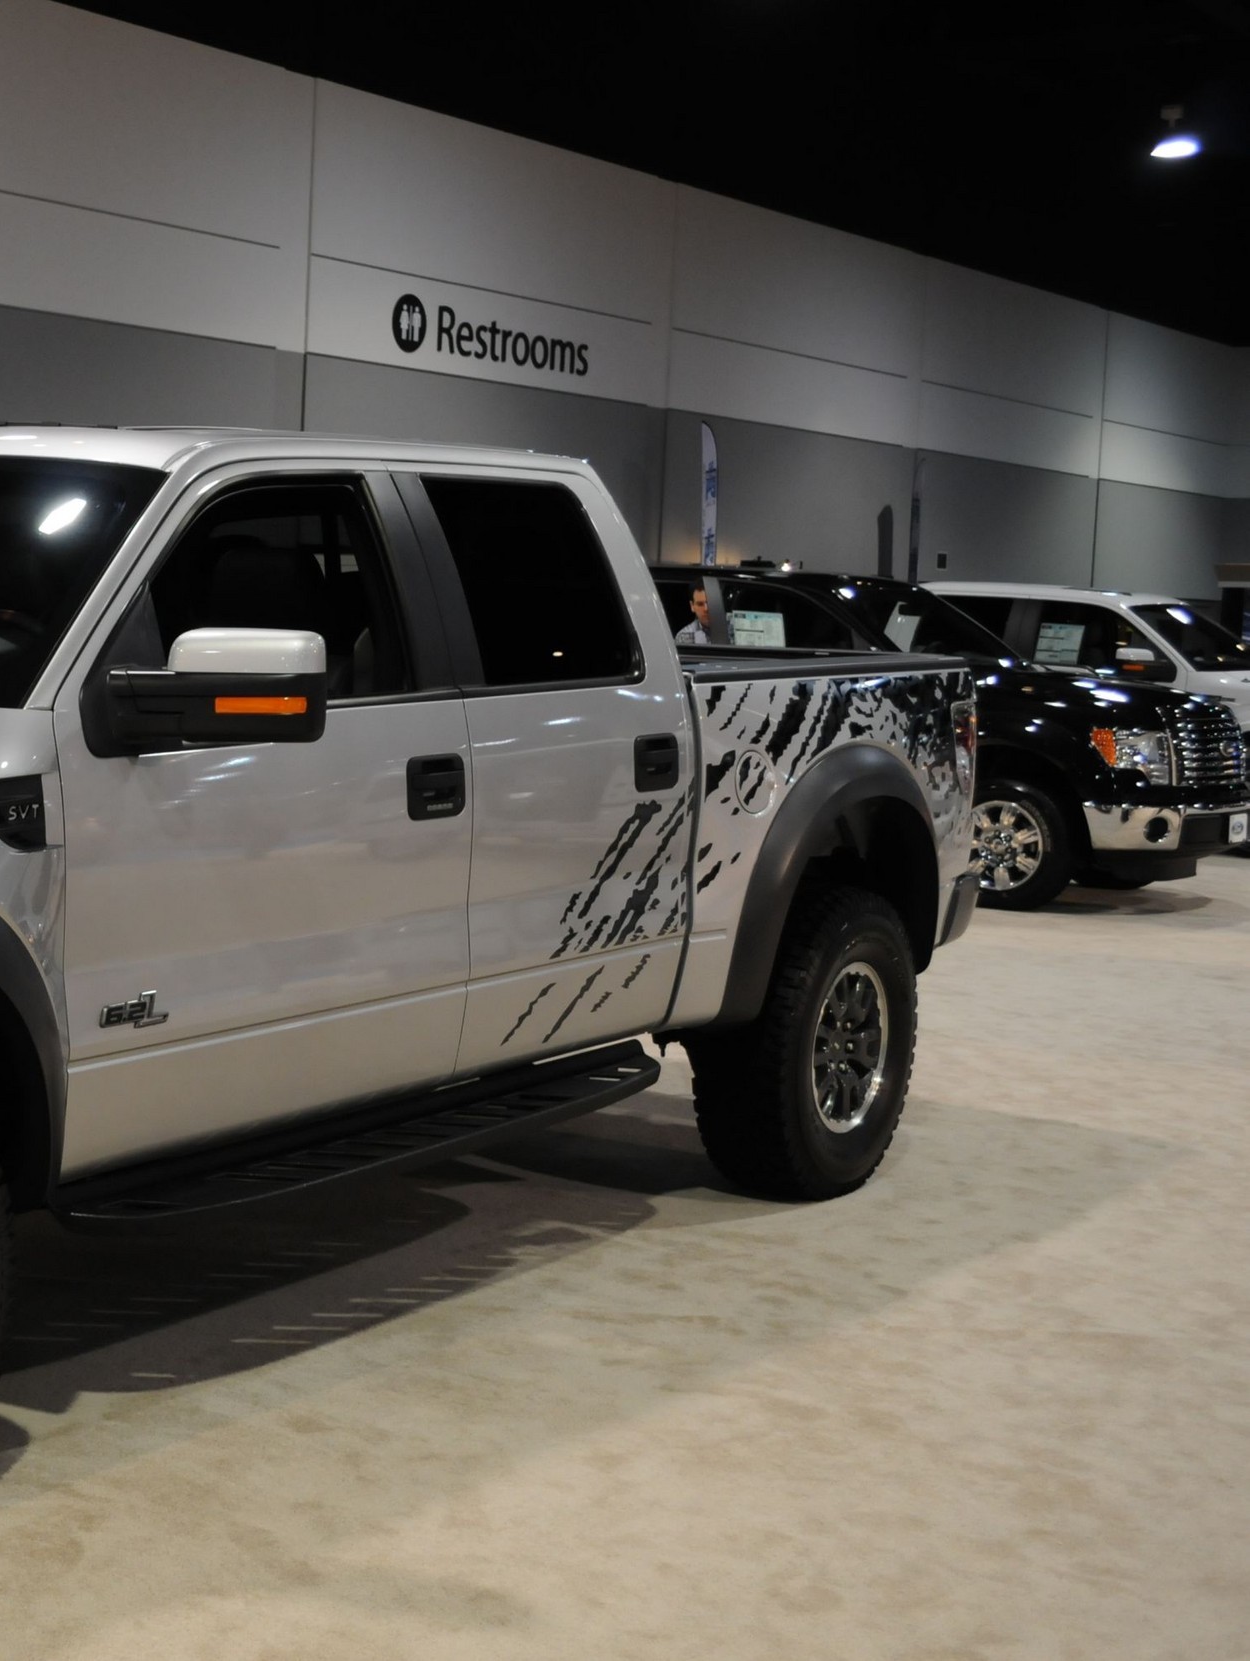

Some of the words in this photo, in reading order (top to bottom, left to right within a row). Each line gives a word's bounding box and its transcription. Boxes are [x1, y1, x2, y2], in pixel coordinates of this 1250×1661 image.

[436, 305, 589, 376] Restrooms
[8, 803, 41, 821] SVT
[99, 990, 169, 1029] 6.2L
